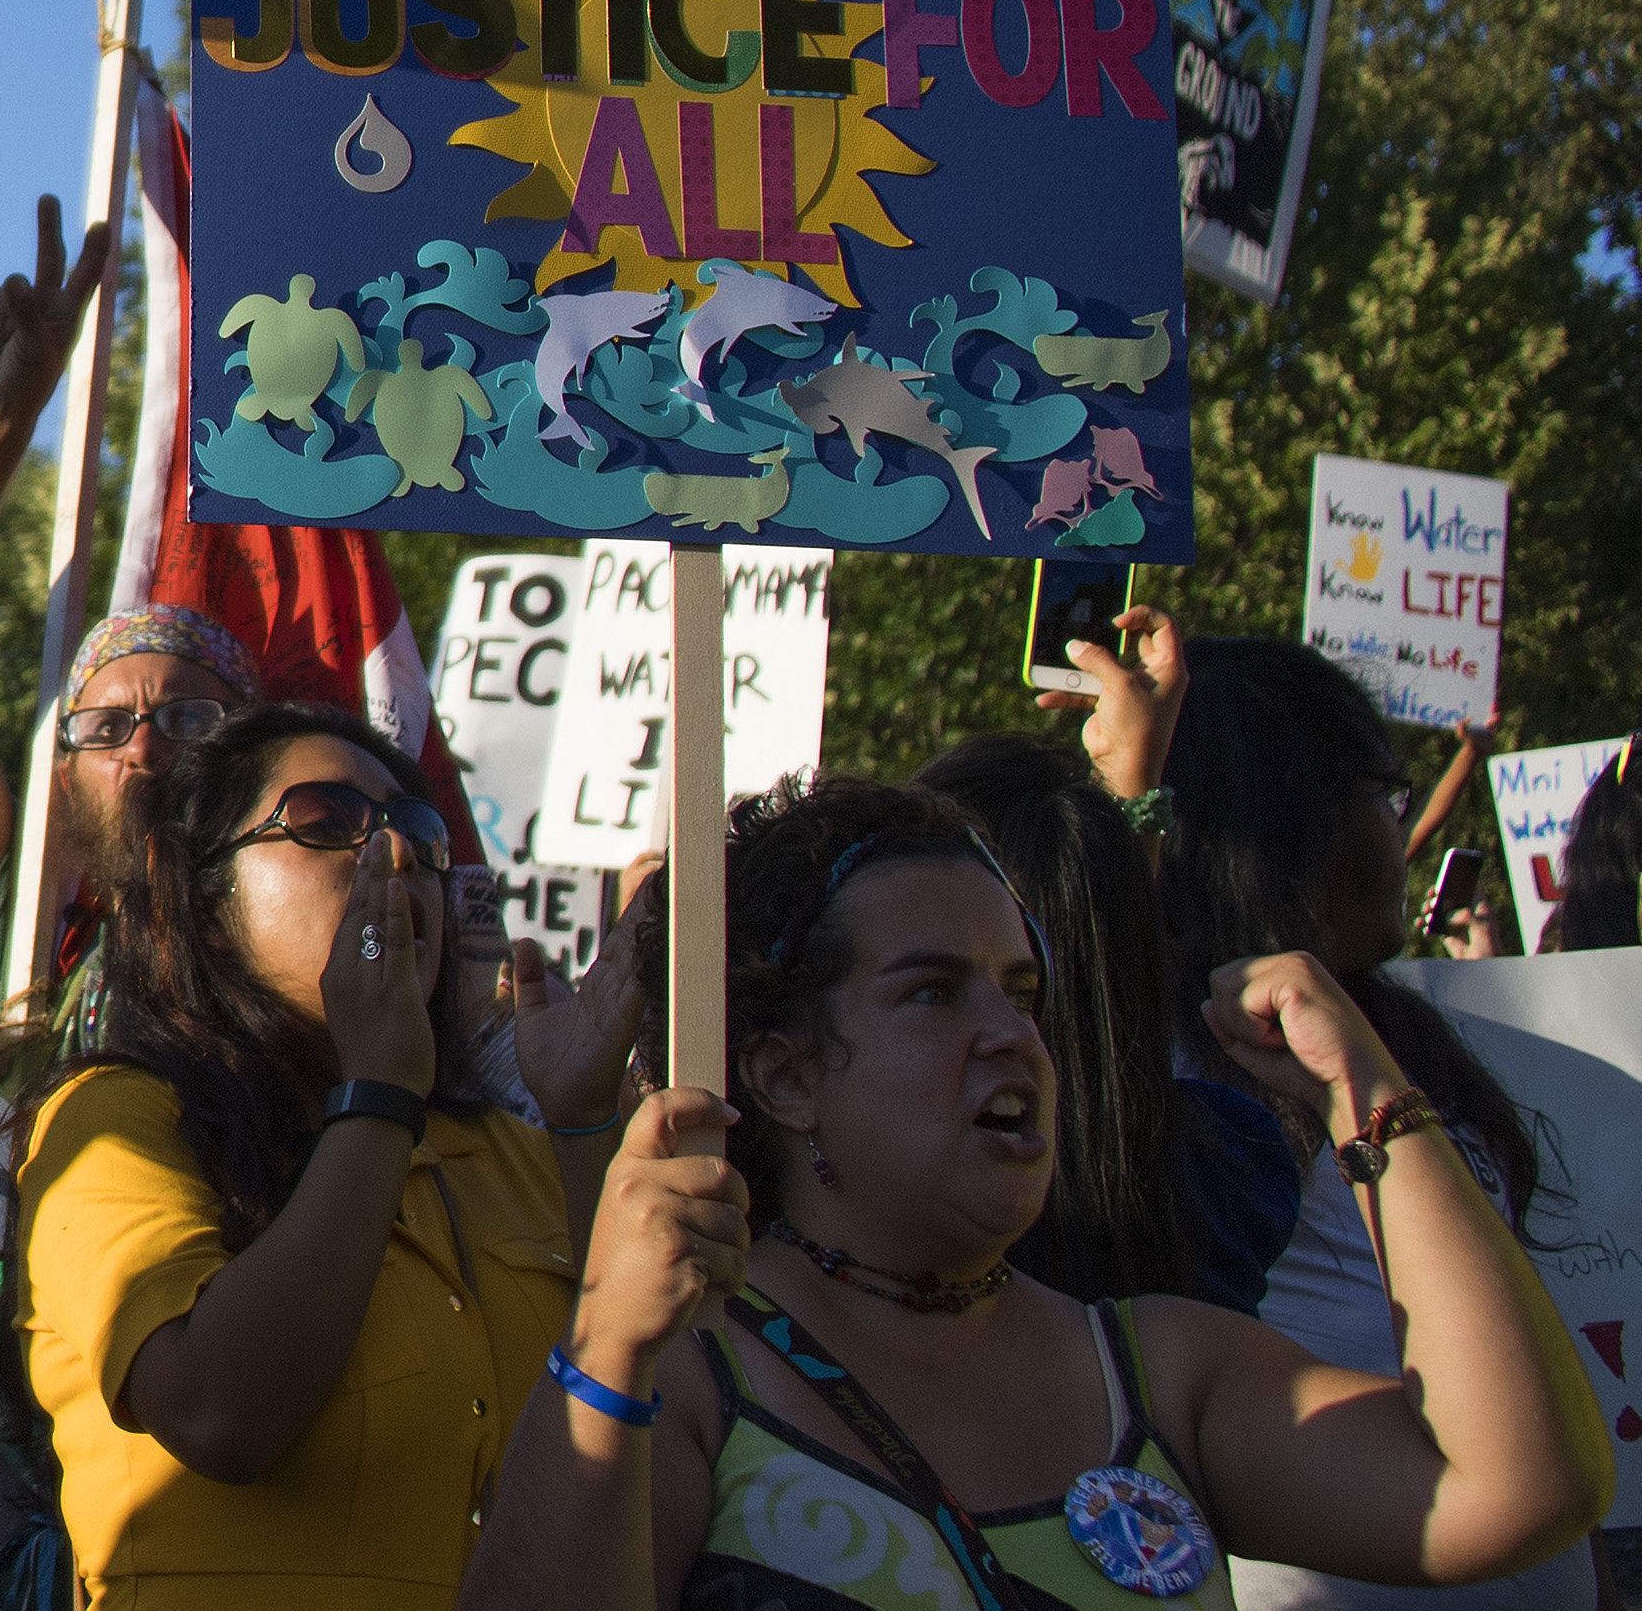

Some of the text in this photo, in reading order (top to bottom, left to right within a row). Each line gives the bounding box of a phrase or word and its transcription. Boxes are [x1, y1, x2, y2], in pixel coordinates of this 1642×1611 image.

[1175, 41, 1263, 141] GROUND
[560, 95, 840, 265] ALL
[1325, 490, 1385, 531] Know
[1401, 485, 1504, 554] Water
[472, 564, 568, 628] TO
[1319, 560, 1385, 605] Know
[1402, 566, 1504, 627] LIFE
[1428, 643, 1480, 680] Life
[1132, 1471, 1211, 1549] REVOLUTION
[1084, 1536, 1118, 1573] FEEL
[1151, 1567, 1195, 1591] BERN
